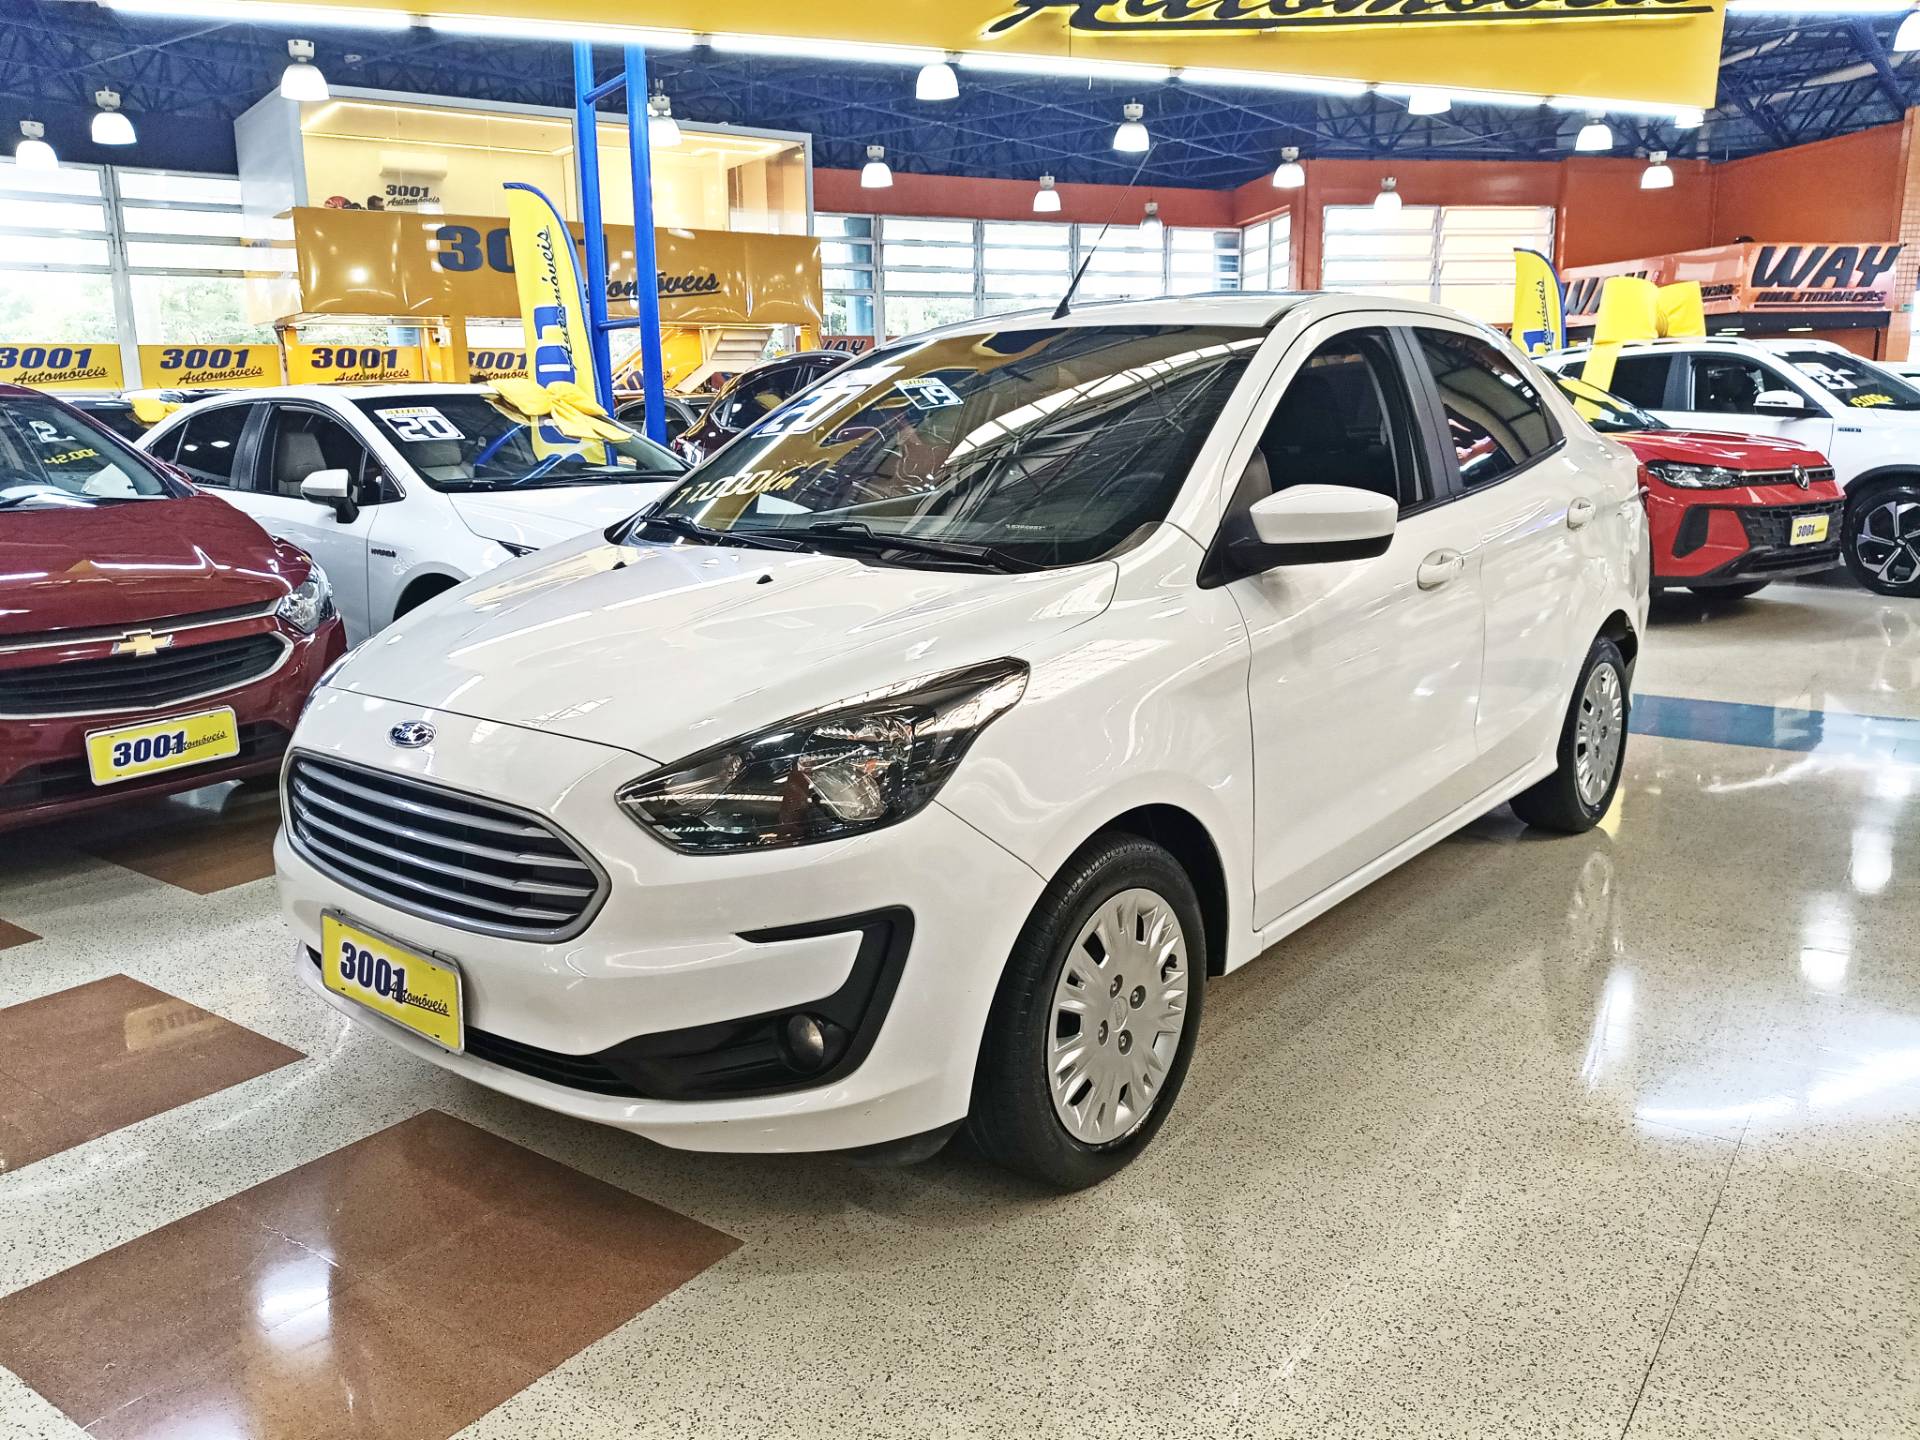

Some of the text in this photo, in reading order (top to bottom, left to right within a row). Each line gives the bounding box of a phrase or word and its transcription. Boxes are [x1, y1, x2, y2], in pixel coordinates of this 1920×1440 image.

[386, 184, 429, 197] 3001
[1751, 246, 1901, 288] WAY
[0, 347, 93, 369] 3001
[160, 348, 250, 369] 3001
[311, 347, 398, 369] 3001
[13, 366, 109, 385] Automóveis
[176, 366, 265, 385] Automóveis
[387, 416, 461, 440] 20
[113, 730, 185, 767] 3001
[340, 941, 405, 1004] 3001
